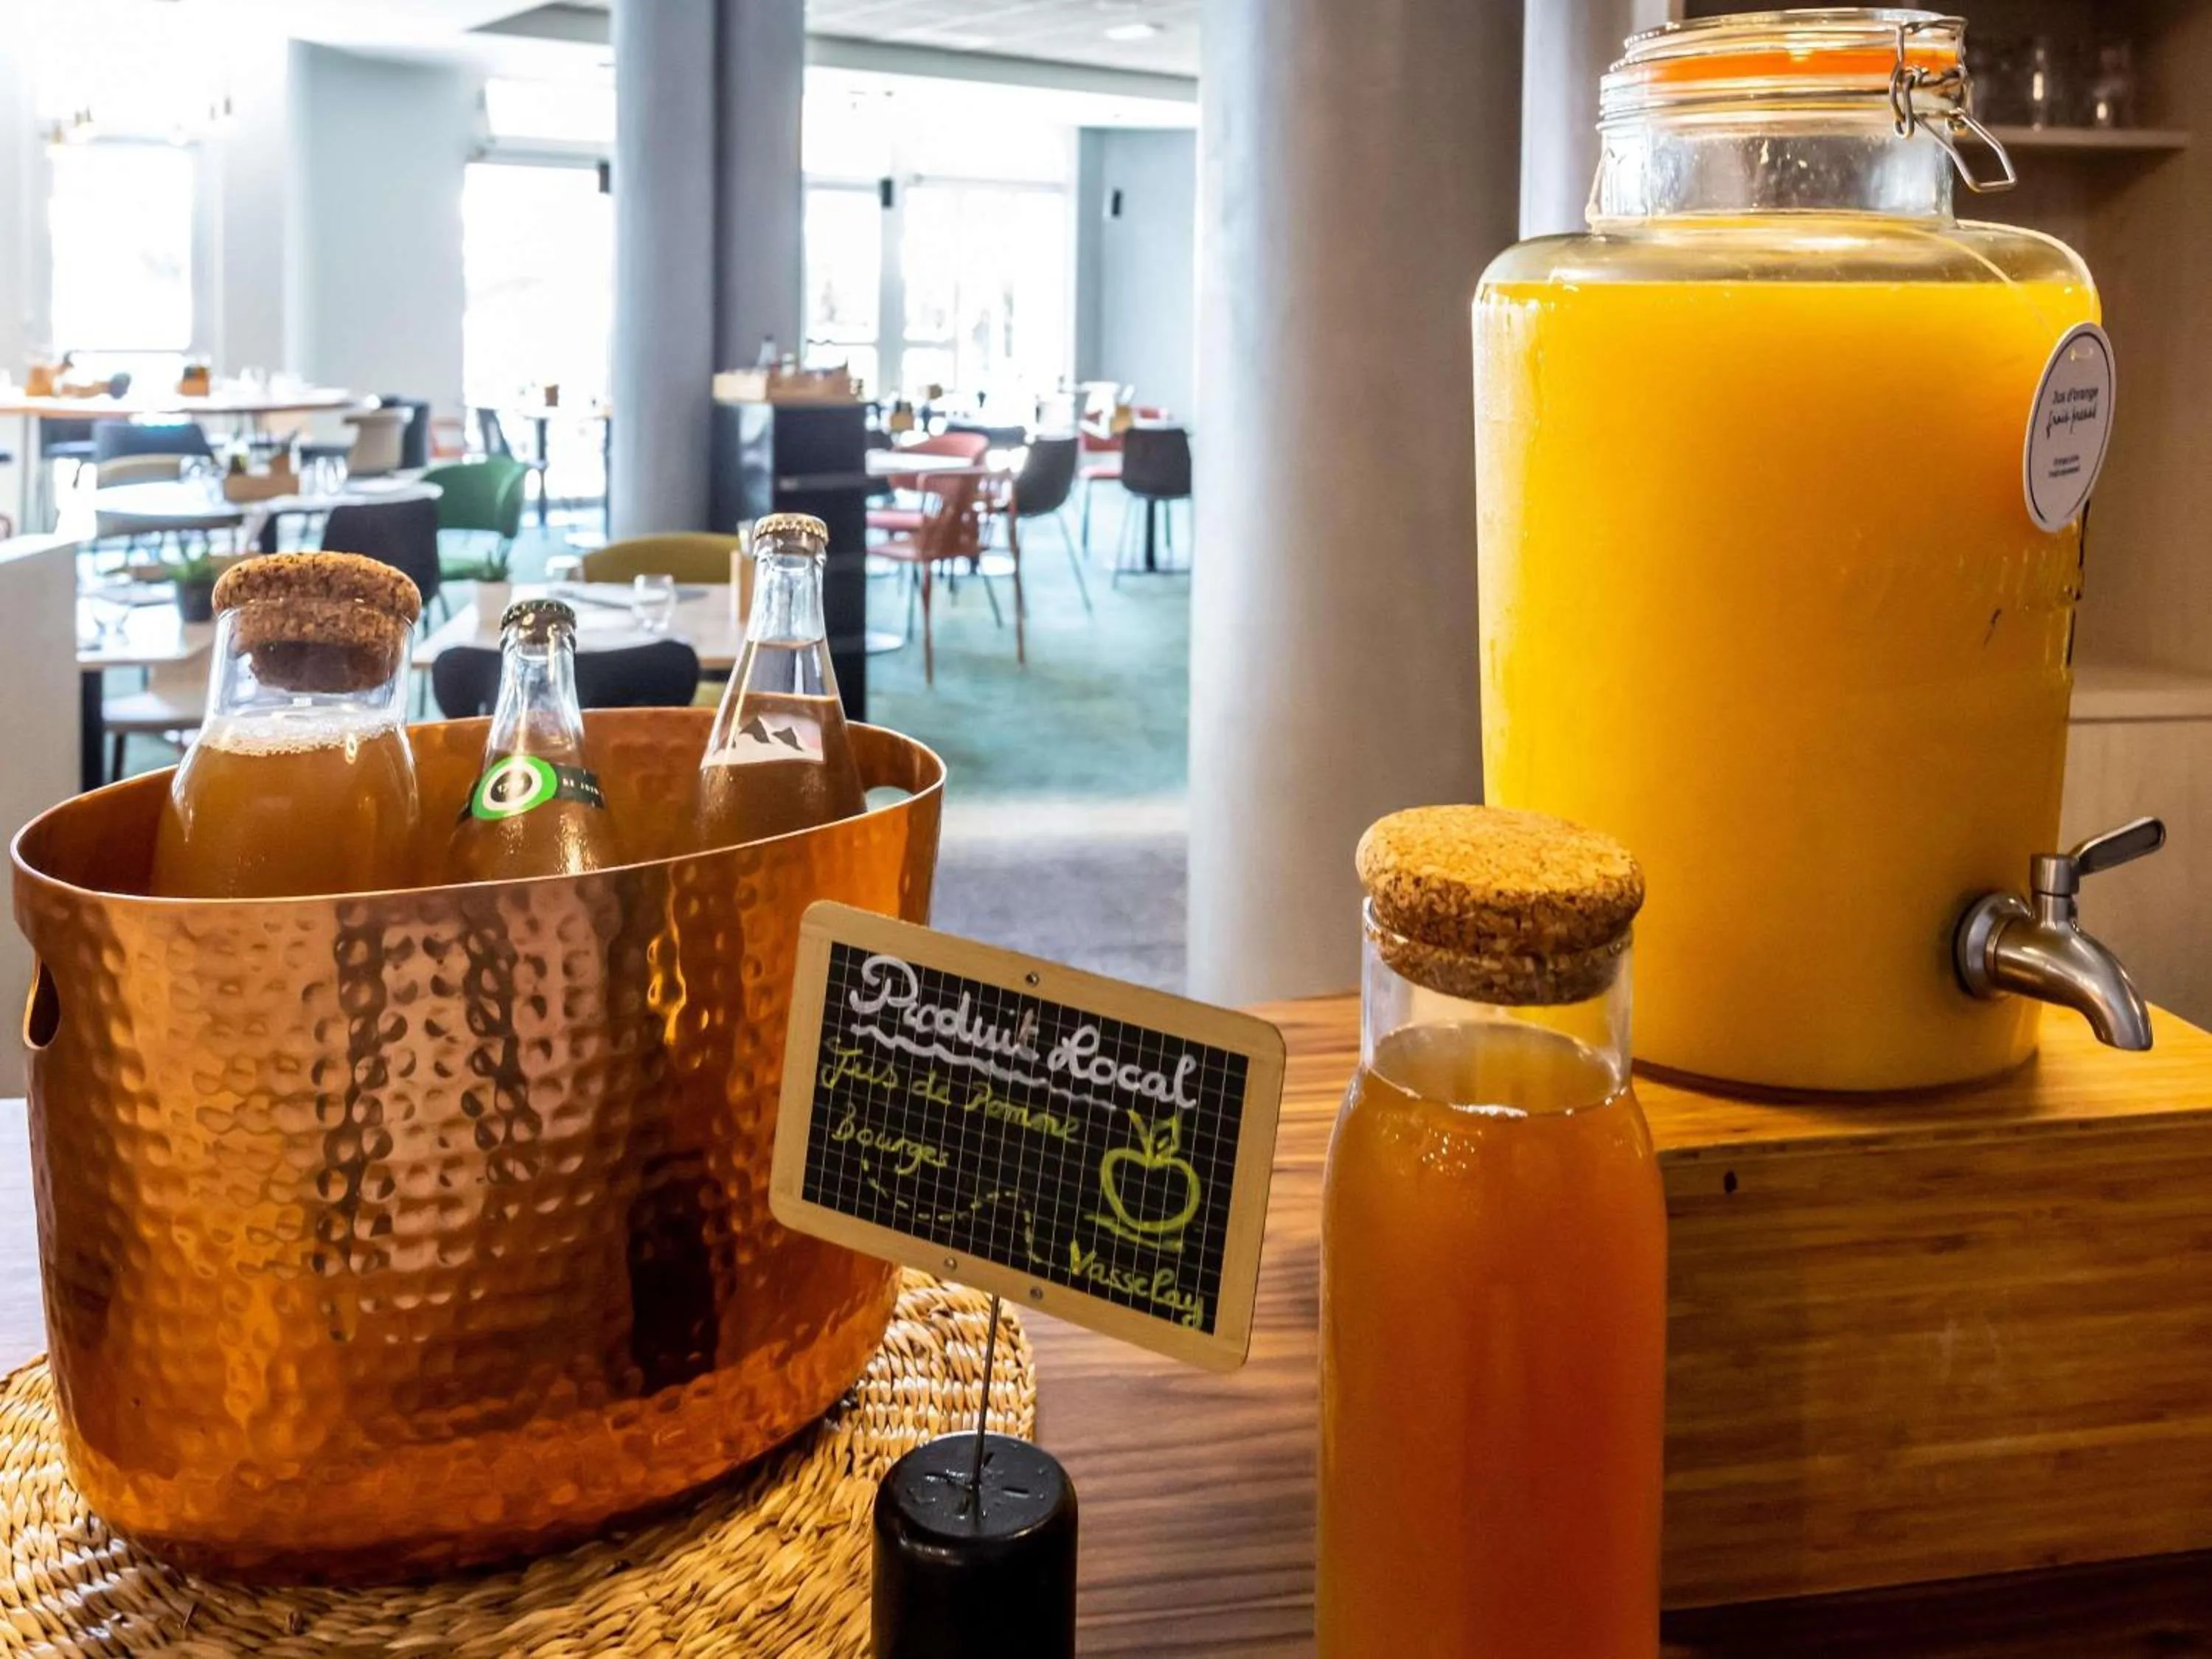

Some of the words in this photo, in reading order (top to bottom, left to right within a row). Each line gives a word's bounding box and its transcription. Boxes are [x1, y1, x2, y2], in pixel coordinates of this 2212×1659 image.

[822, 1037, 897, 1088] Jus
[913, 1070, 950, 1105] de
[849, 955, 1039, 1060] Produit
[1048, 1024, 1196, 1108] Local
[833, 1102, 949, 1175] Bourges
[1070, 1239, 1204, 1327] Vasselay
